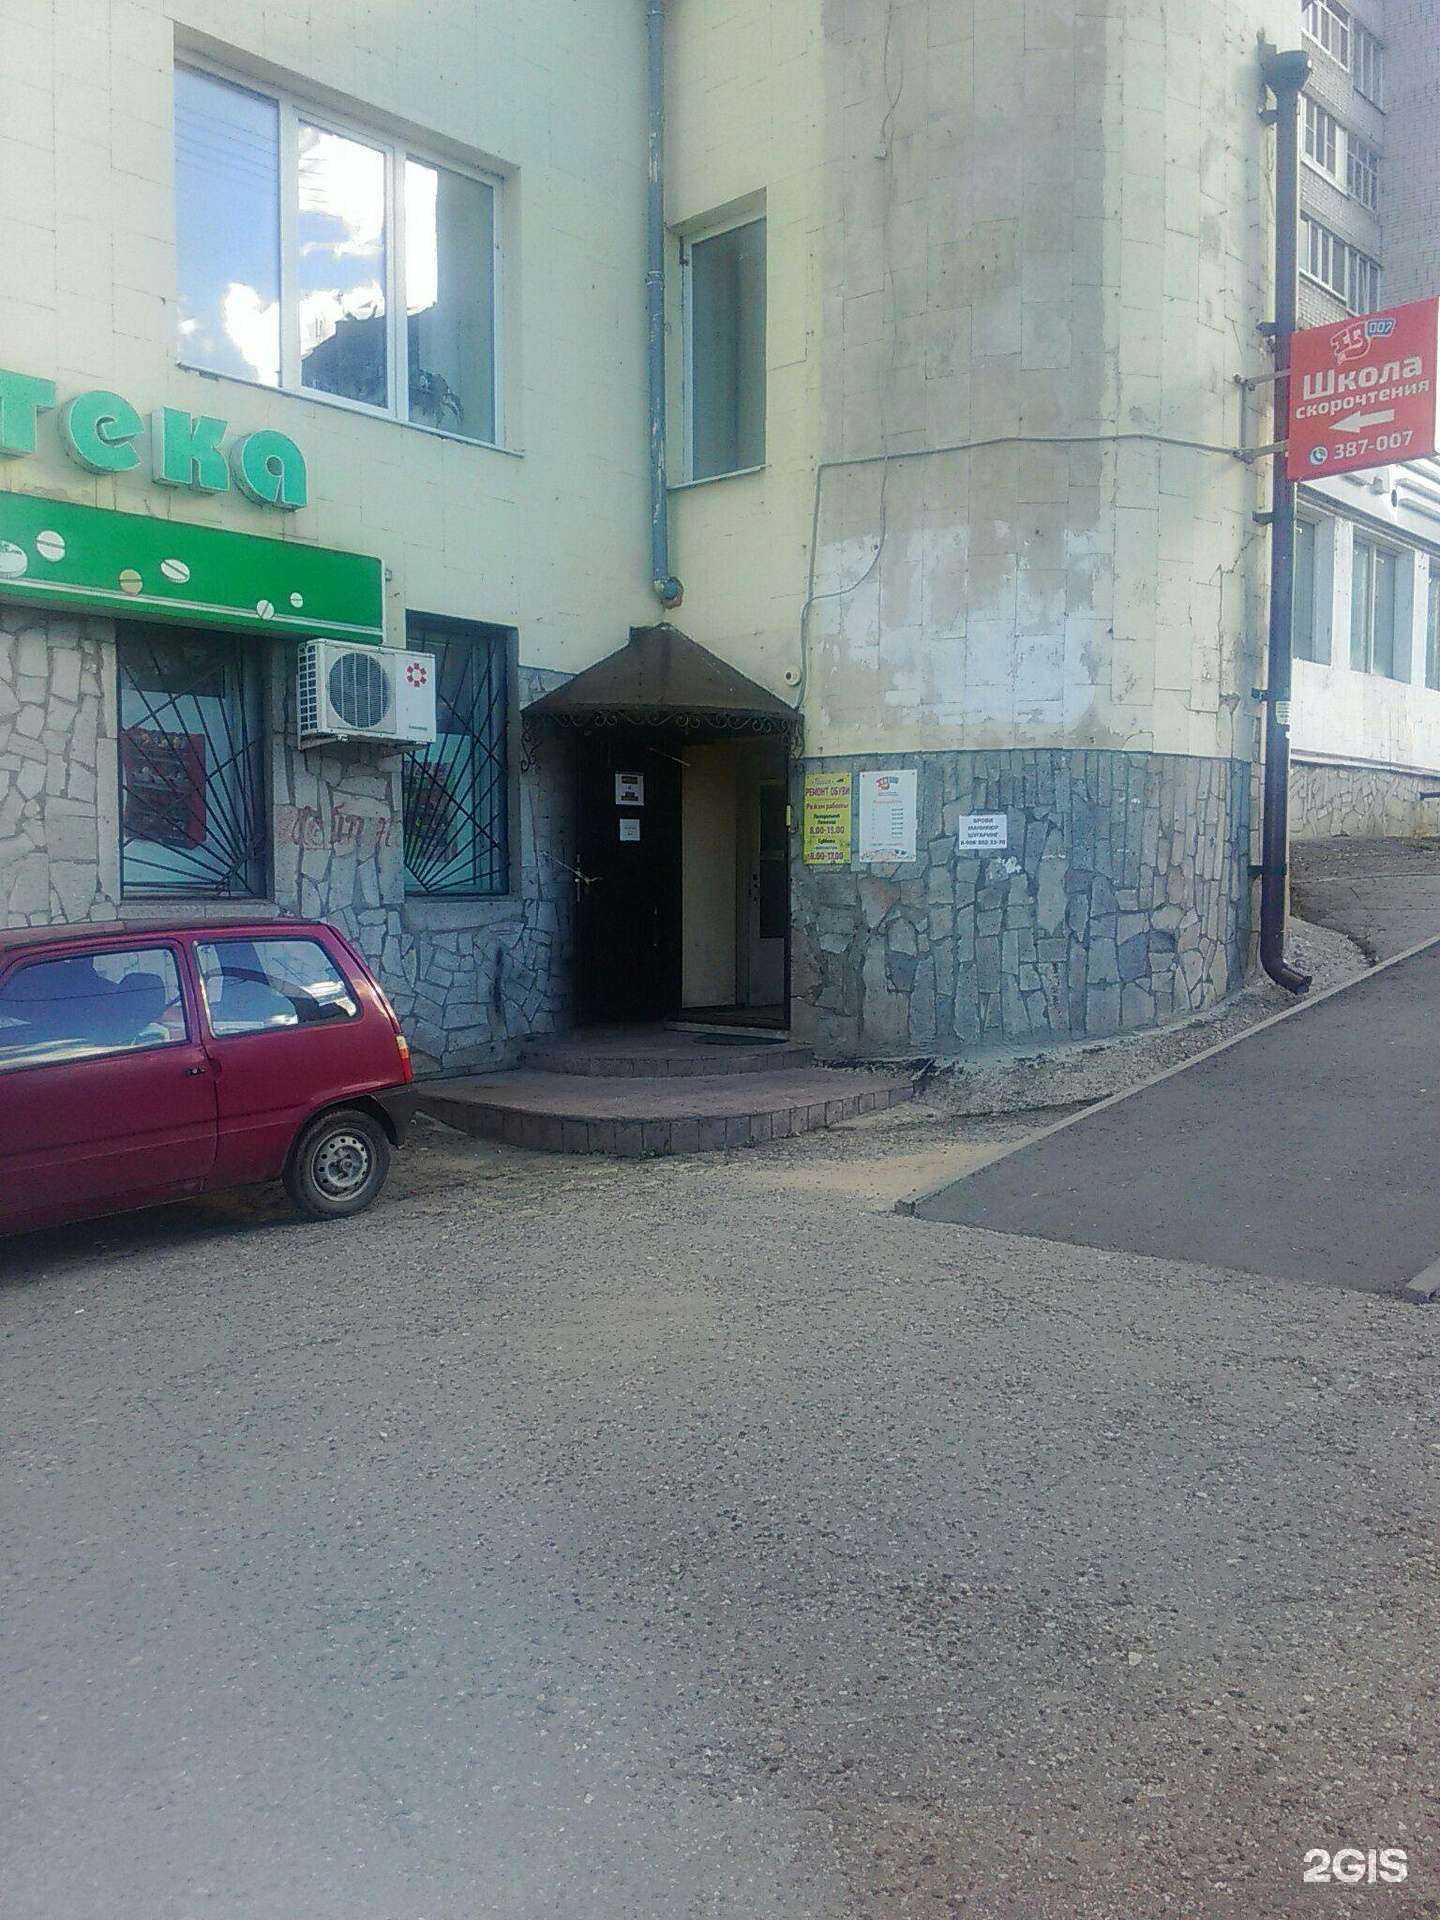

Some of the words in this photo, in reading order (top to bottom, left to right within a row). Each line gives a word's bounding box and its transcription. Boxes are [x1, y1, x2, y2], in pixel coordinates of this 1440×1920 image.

[1369, 321, 1393, 333] 007
[1303, 356, 1422, 401] Школа
[1296, 379, 1430, 419] скорочтения
[1334, 431, 1413, 460] 387-007
